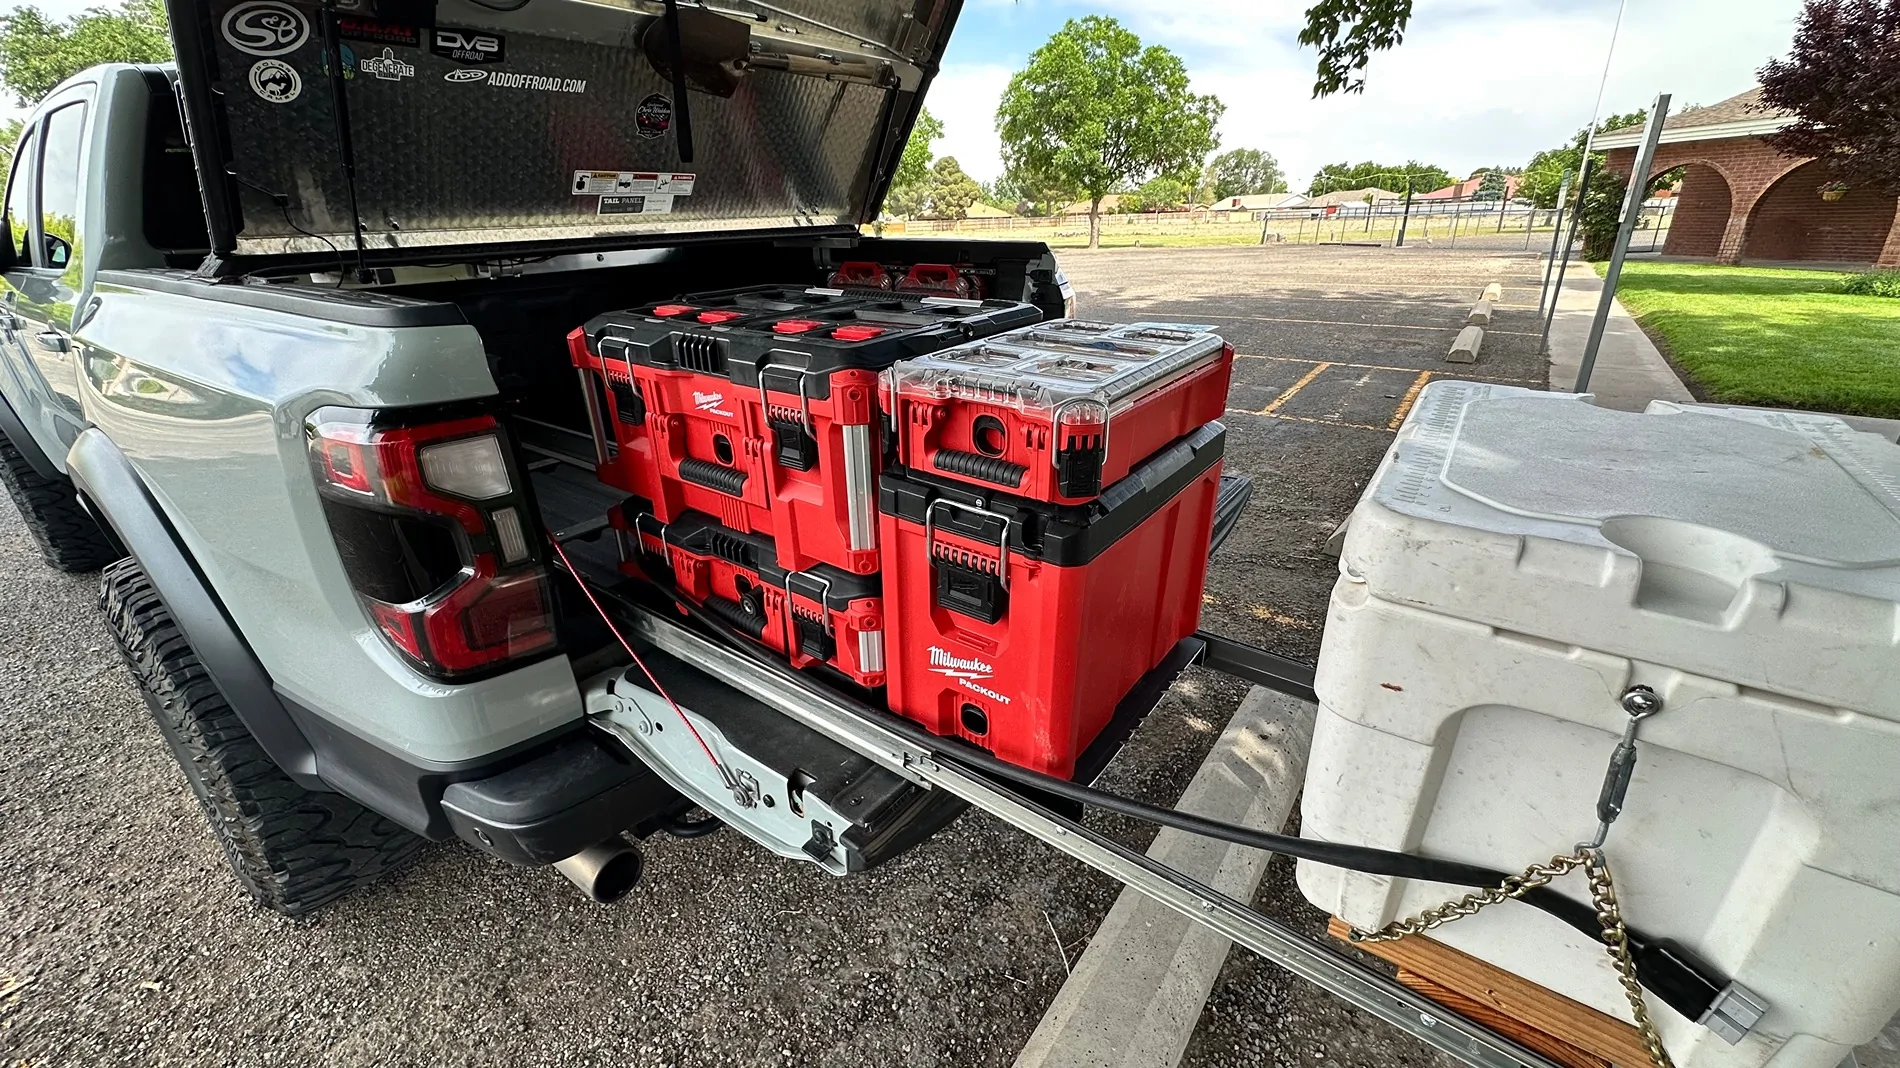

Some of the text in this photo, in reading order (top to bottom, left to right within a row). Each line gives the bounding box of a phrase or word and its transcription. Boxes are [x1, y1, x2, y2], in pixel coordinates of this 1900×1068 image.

[235, 9, 297, 47] S&B
[436, 31, 499, 52] DV8
[452, 49, 484, 61] OFFROAD
[256, 61, 292, 73] POLAR
[362, 60, 413, 76] DEGENERATE
[487, 71, 587, 93] ADDOFFROAD.COM
[259, 89, 296, 101] CAMEL
[692, 390, 723, 406] Milwaukee
[709, 408, 734, 418] PACKOUT
[926, 645, 994, 673] Milwaukee
[958, 677, 1012, 705] PACKOUT
